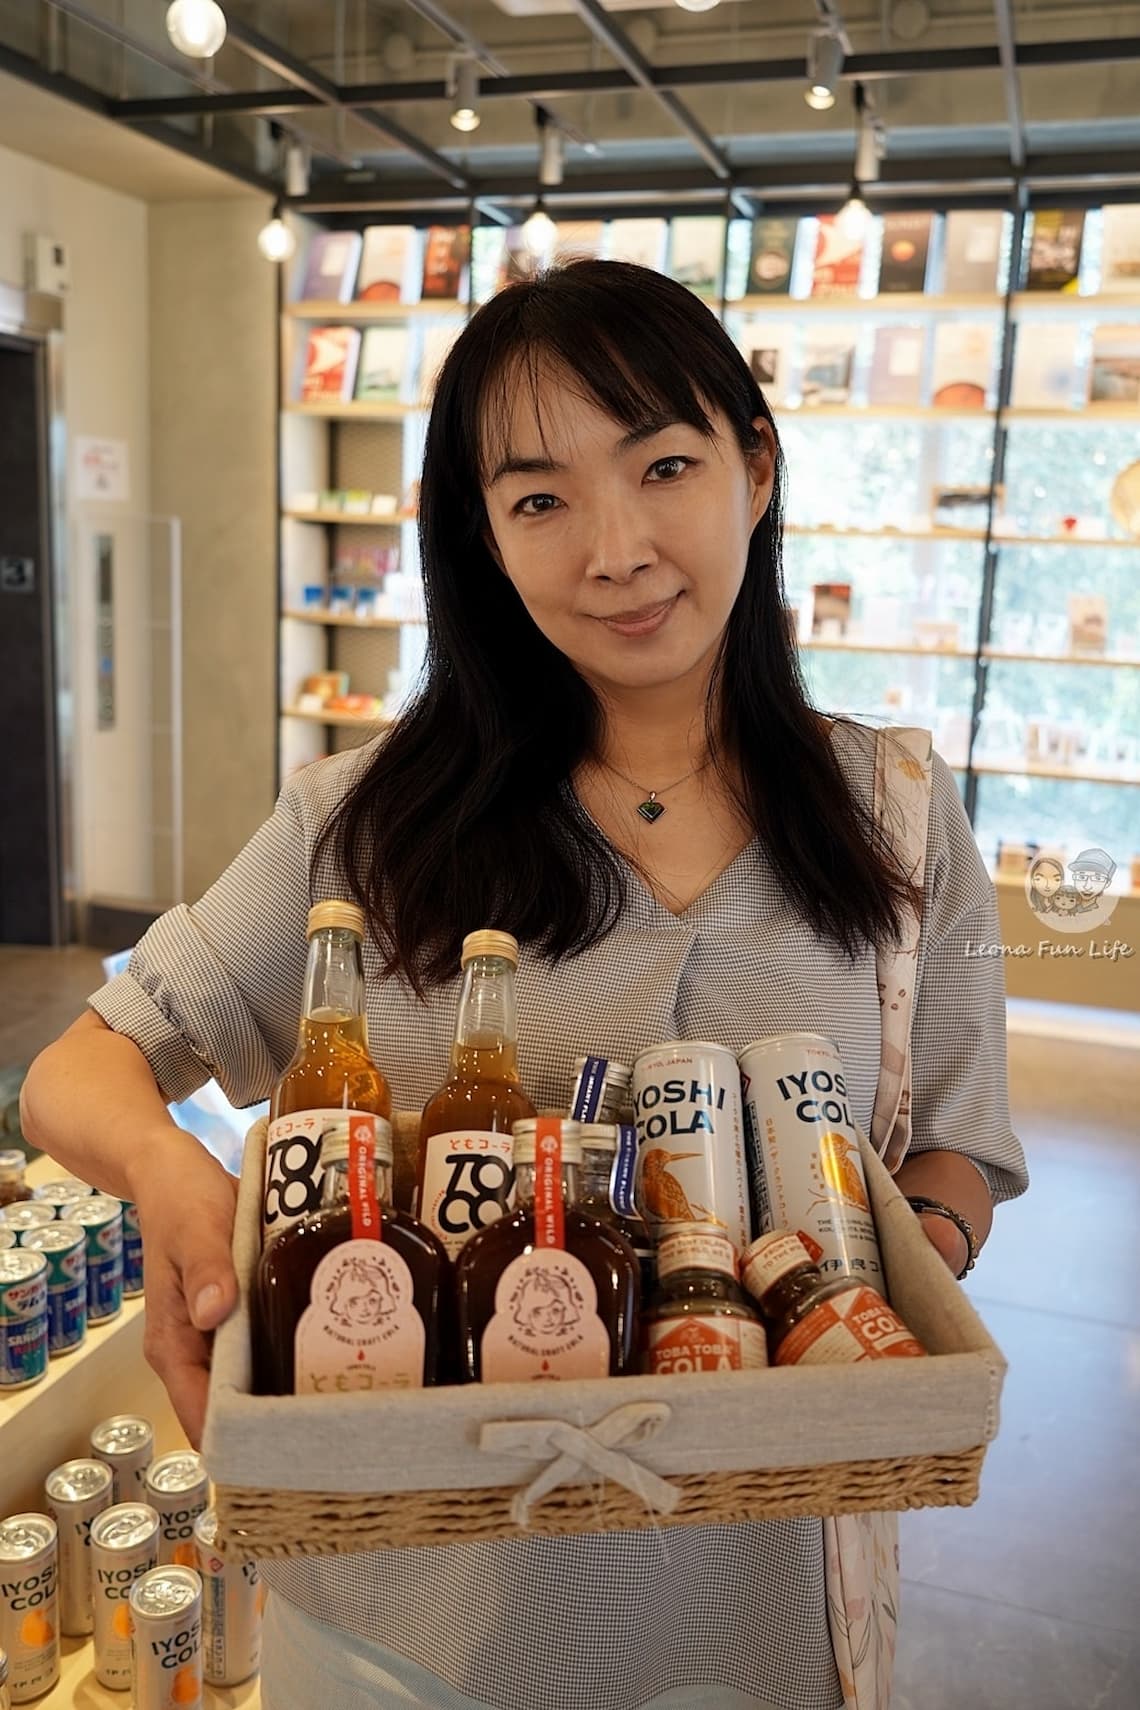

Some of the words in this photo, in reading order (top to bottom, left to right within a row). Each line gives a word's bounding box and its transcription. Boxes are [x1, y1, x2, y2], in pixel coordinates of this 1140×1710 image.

[449, 1138, 511, 1153] ともコーラ
[358, 1145, 369, 1201] ORIGINAL
[543, 1157, 554, 1213] ORIGINAL
[545, 1214, 556, 1244] WILD
[656, 1346, 691, 1360] TOBA
